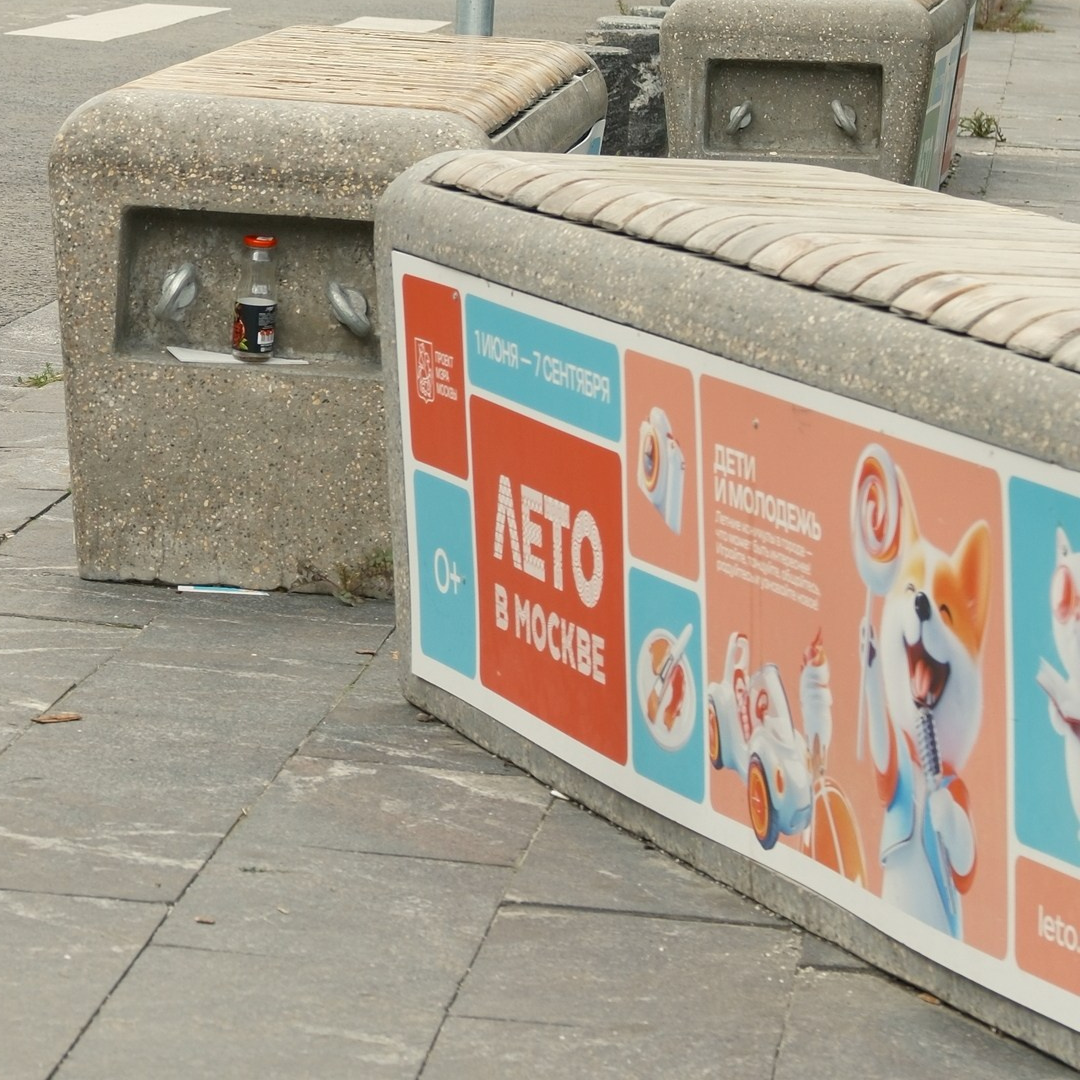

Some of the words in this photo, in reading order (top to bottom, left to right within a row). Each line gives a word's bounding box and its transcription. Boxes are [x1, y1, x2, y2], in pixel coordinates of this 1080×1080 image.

[474, 330, 481, 355] 1
[481, 331, 519, 370] ИЮНЯ
[532, 350, 541, 377] 7
[542, 354, 610, 404] СЕНТЯБРЯ
[713, 443, 757, 483] ДЕТИ
[493, 474, 604, 609] ЛЕТО
[713, 475, 727, 505] И
[728, 480, 822, 542] МОЛОДЕЖЬ
[434, 547, 461, 595] 0+
[494, 582, 509, 632] В
[514, 592, 606, 685] МОСКВЕ
